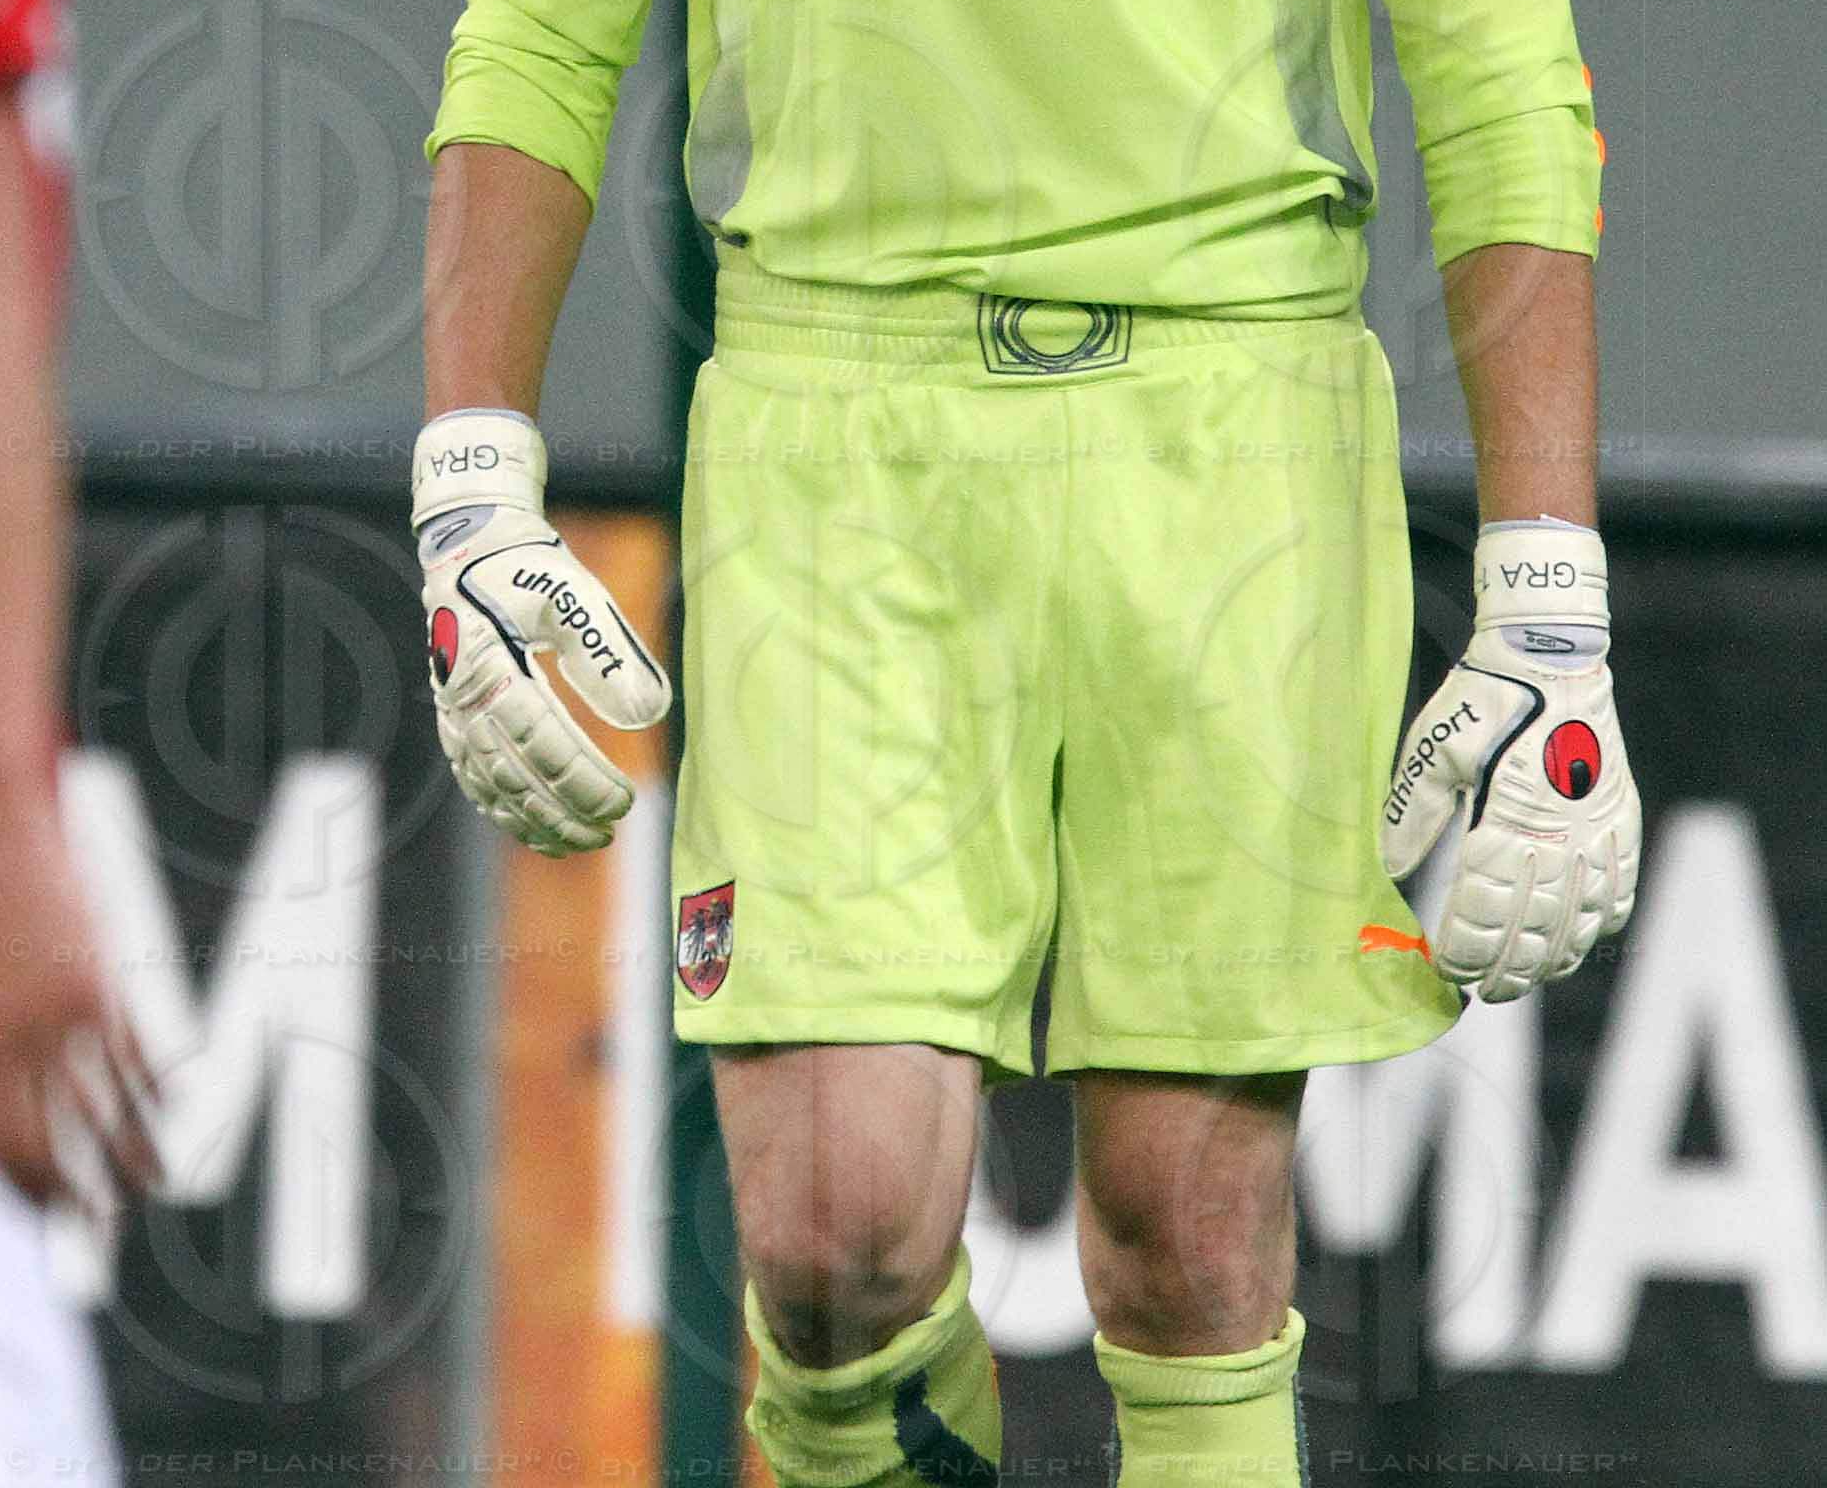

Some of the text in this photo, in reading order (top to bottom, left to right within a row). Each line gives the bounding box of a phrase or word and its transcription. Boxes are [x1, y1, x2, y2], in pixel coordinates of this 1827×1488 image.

[430, 444, 499, 478] GRA
[1500, 562, 1576, 589] GRA
[512, 568, 624, 679] uhlsport
[1386, 701, 1481, 825] uhlsport
